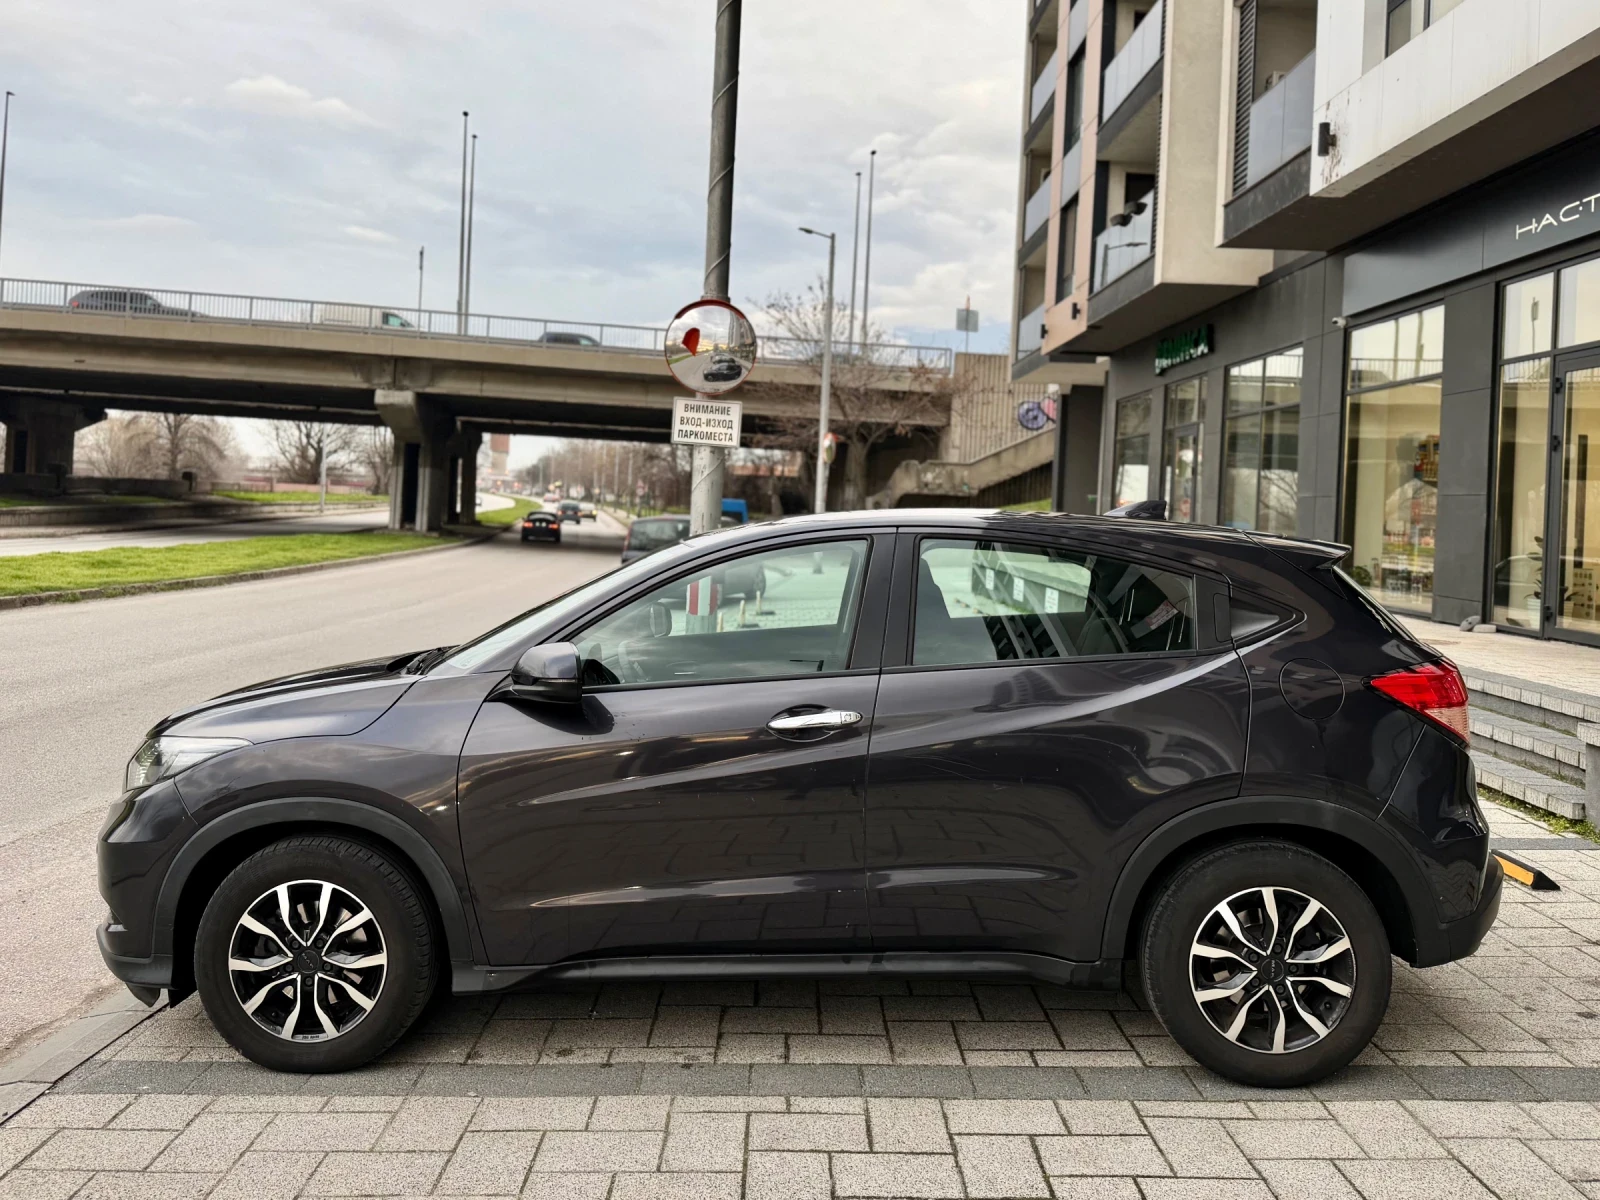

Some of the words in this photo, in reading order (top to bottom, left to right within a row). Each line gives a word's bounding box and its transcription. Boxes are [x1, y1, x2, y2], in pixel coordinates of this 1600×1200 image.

[684, 403, 731, 416] ВНИМАНИЕ
[680, 416, 734, 430] ВХОД-ИЗХОД
[677, 429, 733, 442] ПАРКОМЕСТА
